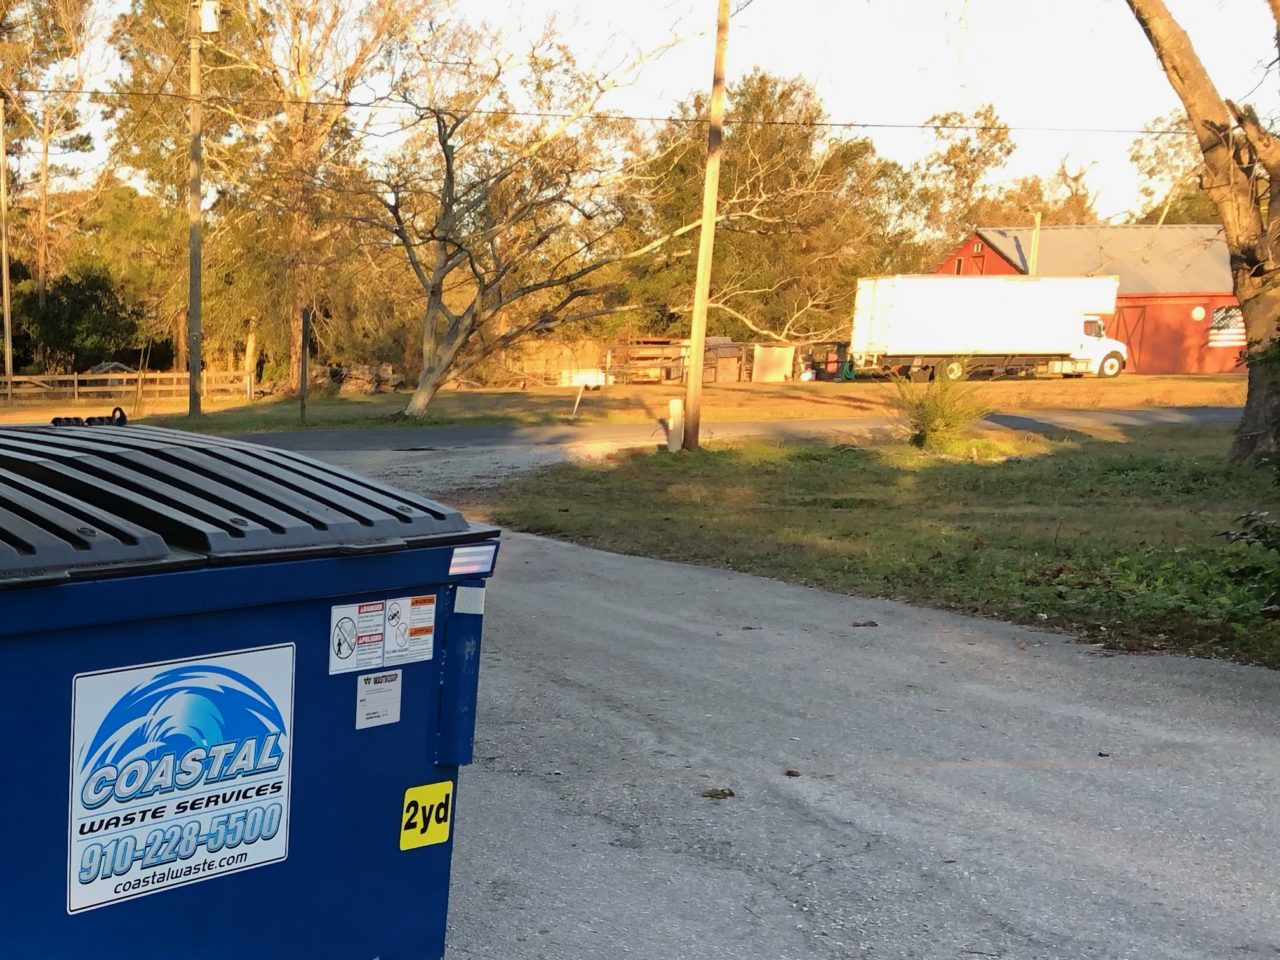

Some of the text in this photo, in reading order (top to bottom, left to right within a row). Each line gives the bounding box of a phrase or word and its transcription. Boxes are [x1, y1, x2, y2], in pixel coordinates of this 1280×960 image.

[81, 732, 284, 810] COASTAL
[79, 781, 283, 836] WASTE SERVICES
[404, 793, 450, 835] 2yd
[78, 803, 283, 885] 910-228-5500
[113, 852, 248, 894] coastalwaste.com
